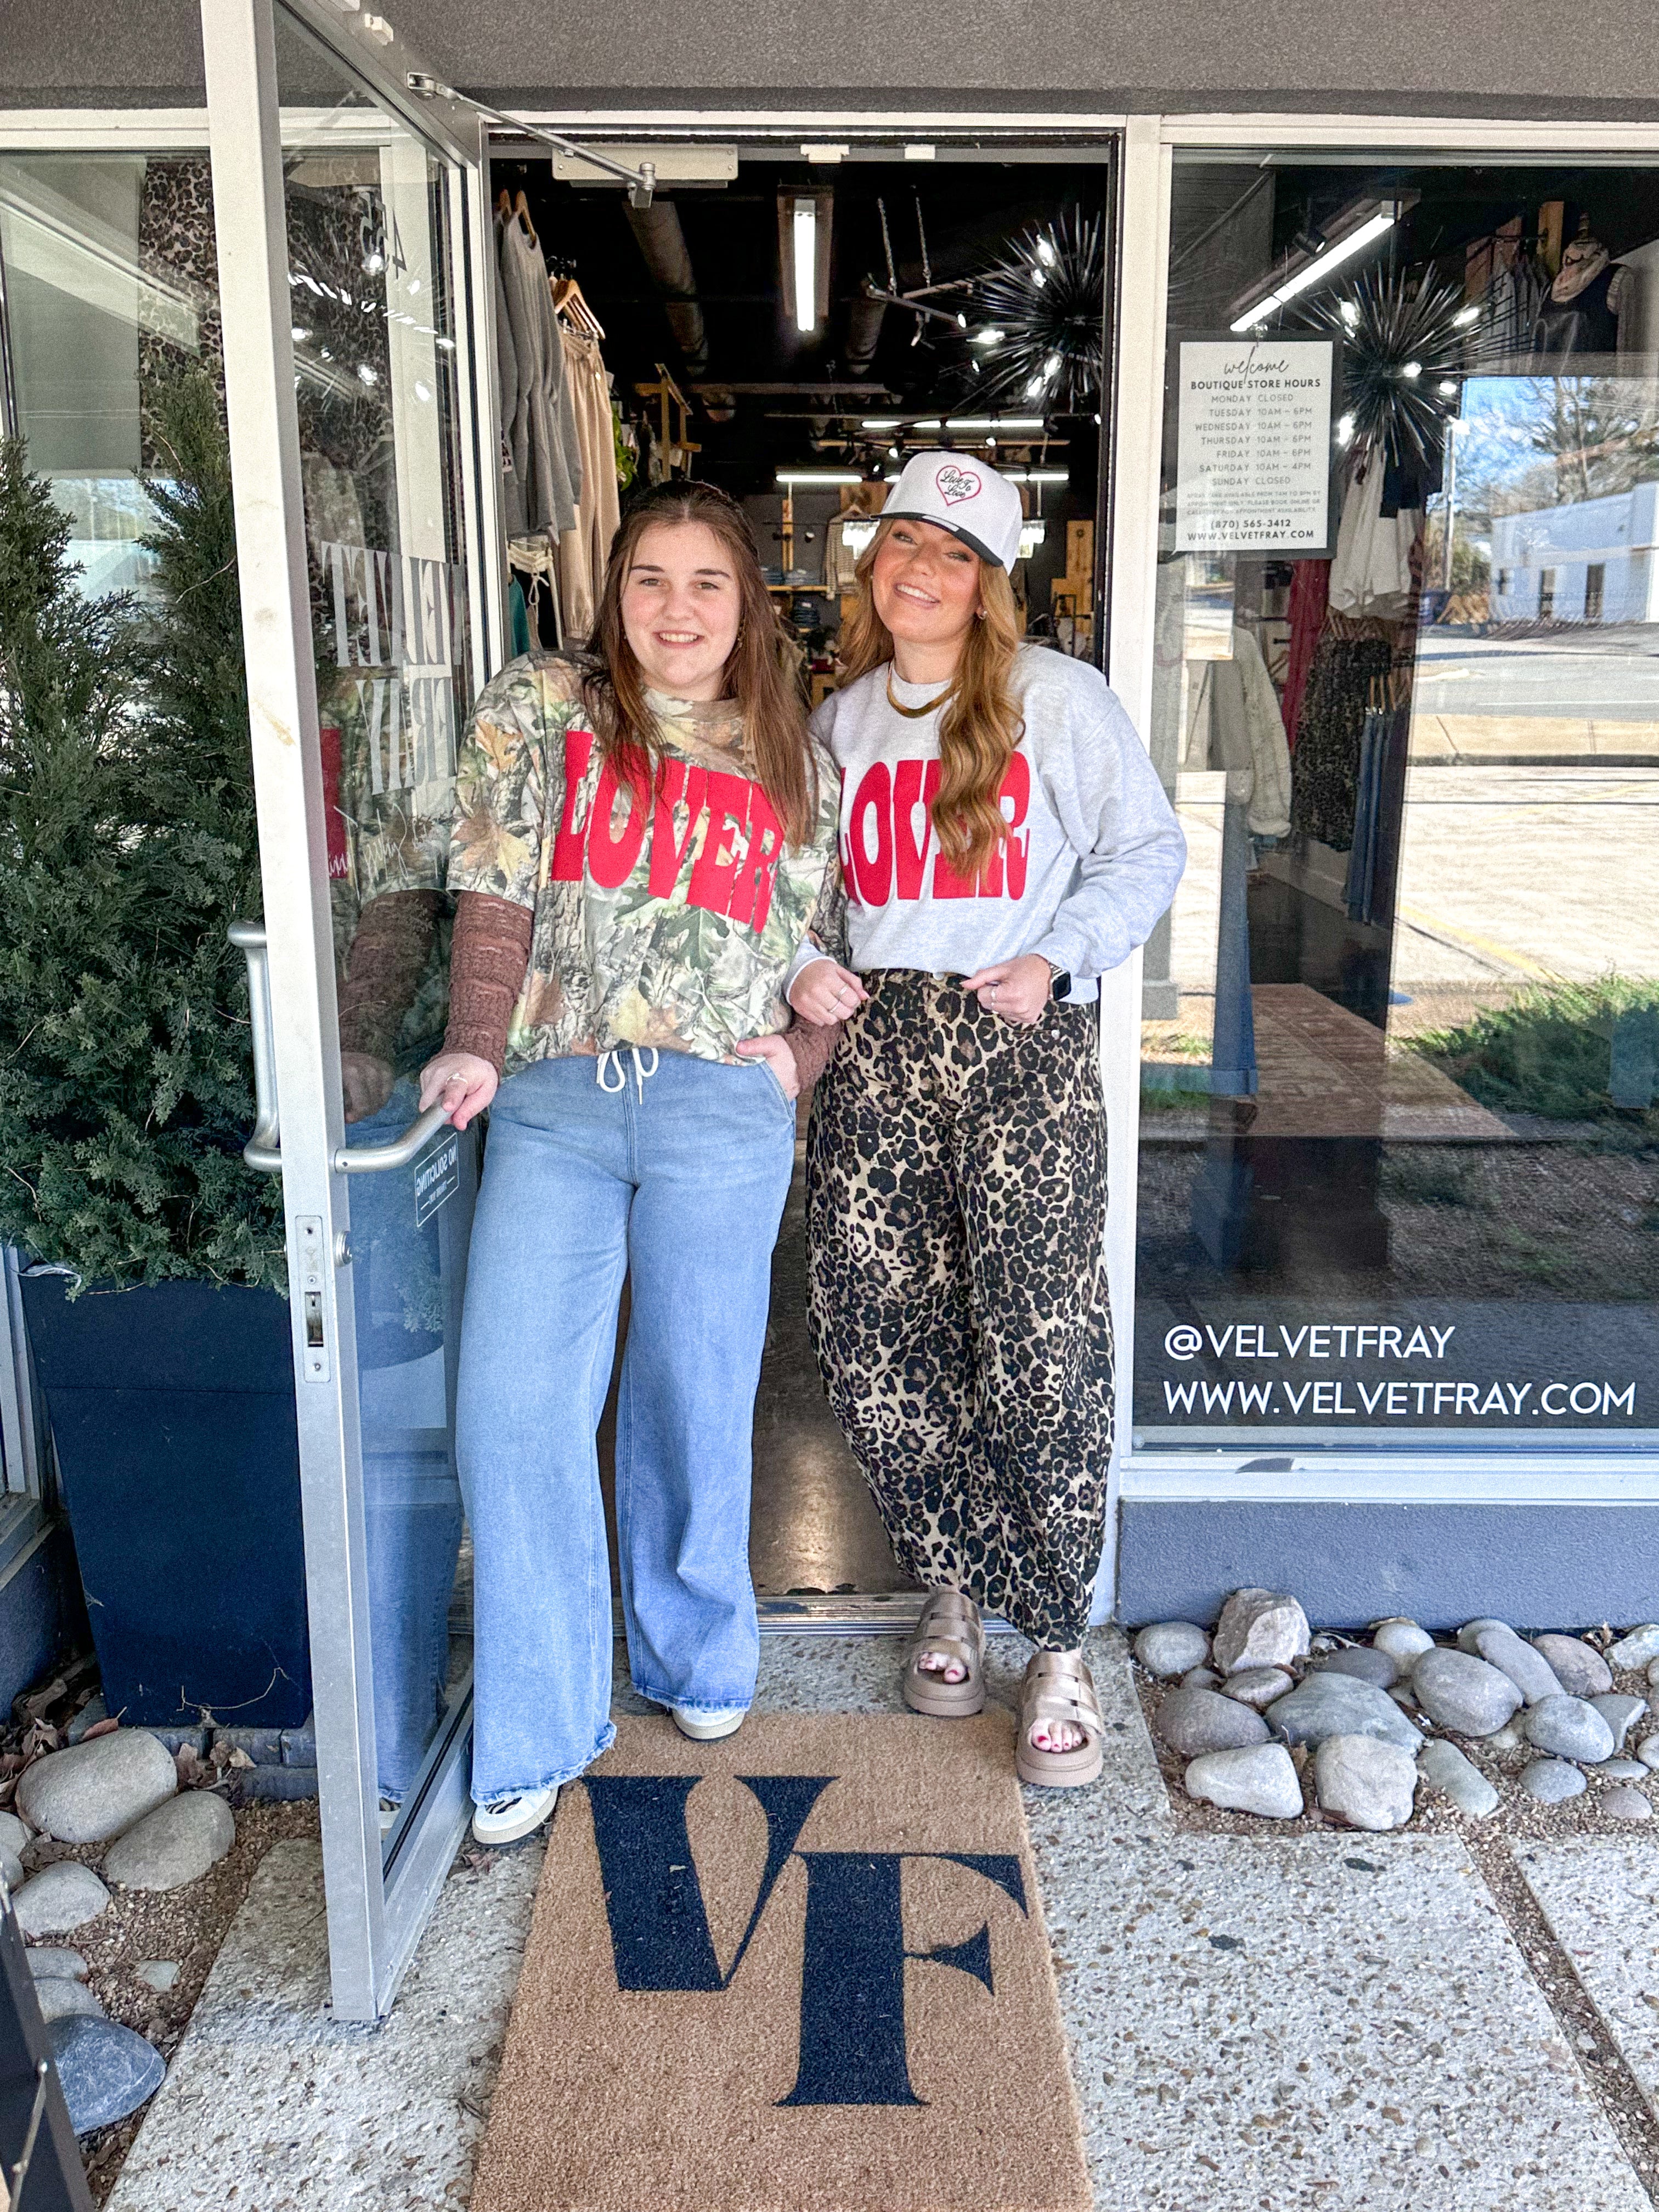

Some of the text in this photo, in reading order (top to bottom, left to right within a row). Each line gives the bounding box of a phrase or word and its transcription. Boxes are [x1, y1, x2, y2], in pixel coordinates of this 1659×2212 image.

[1224, 346, 1290, 383] welcome
[1190, 379, 1321, 390] BOUTIQUE STORE HOURS
[1211, 394, 1294, 403] MONDAY CLOSED
[1209, 409, 1251, 417] TUESDAY
[1195, 422, 1251, 431] WEDNESDAY
[1293, 421, 1312, 429] 6PM
[1201, 436, 1250, 445] THURSDAY
[1216, 450, 1250, 458] FRIDAY
[1199, 464, 1250, 472] SATURDAY
[1212, 477, 1291, 486] SUNDAY CLOSED
[1211, 519, 1291, 530] (870) 565-3412
[1187, 530, 1314, 541] WWW.VELVETFRAY.COM
[551, 730, 785, 934] LOVER
[1164, 1324, 1456, 1361] @VELVETFRAY
[1163, 1380, 1637, 1415] WWW.VELVETFRAY.COM
